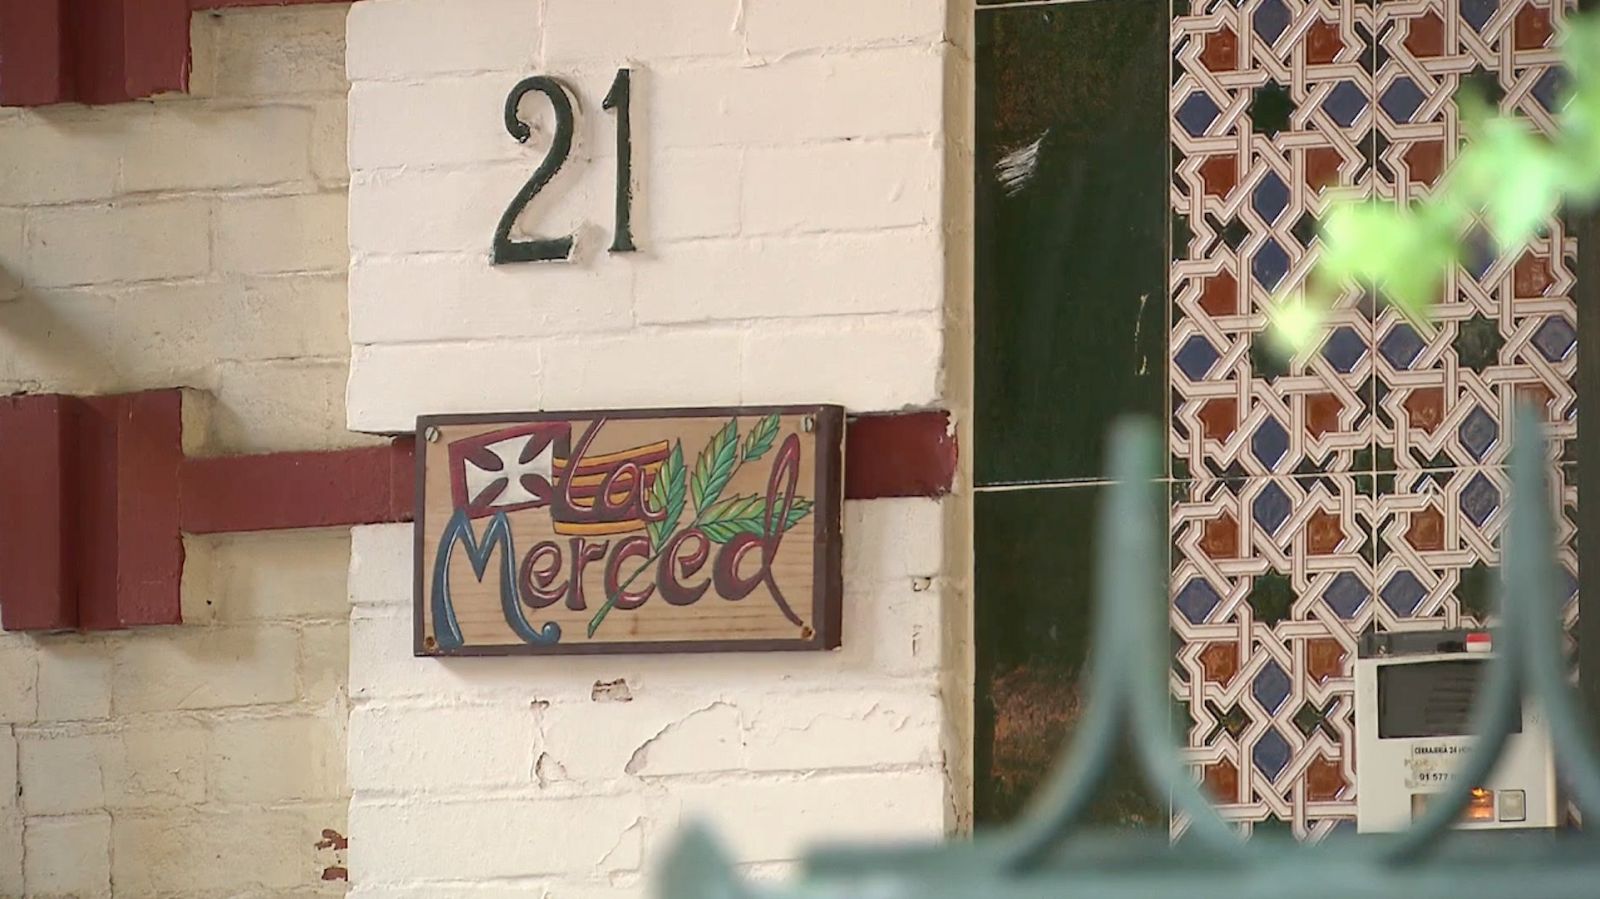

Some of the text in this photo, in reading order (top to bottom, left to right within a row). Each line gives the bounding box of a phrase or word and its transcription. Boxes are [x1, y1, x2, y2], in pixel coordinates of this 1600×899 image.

[490, 68, 636, 264] 21
[430, 432, 803, 648] Merced
[551, 417, 669, 521] La
[1419, 773, 1429, 781] 91
